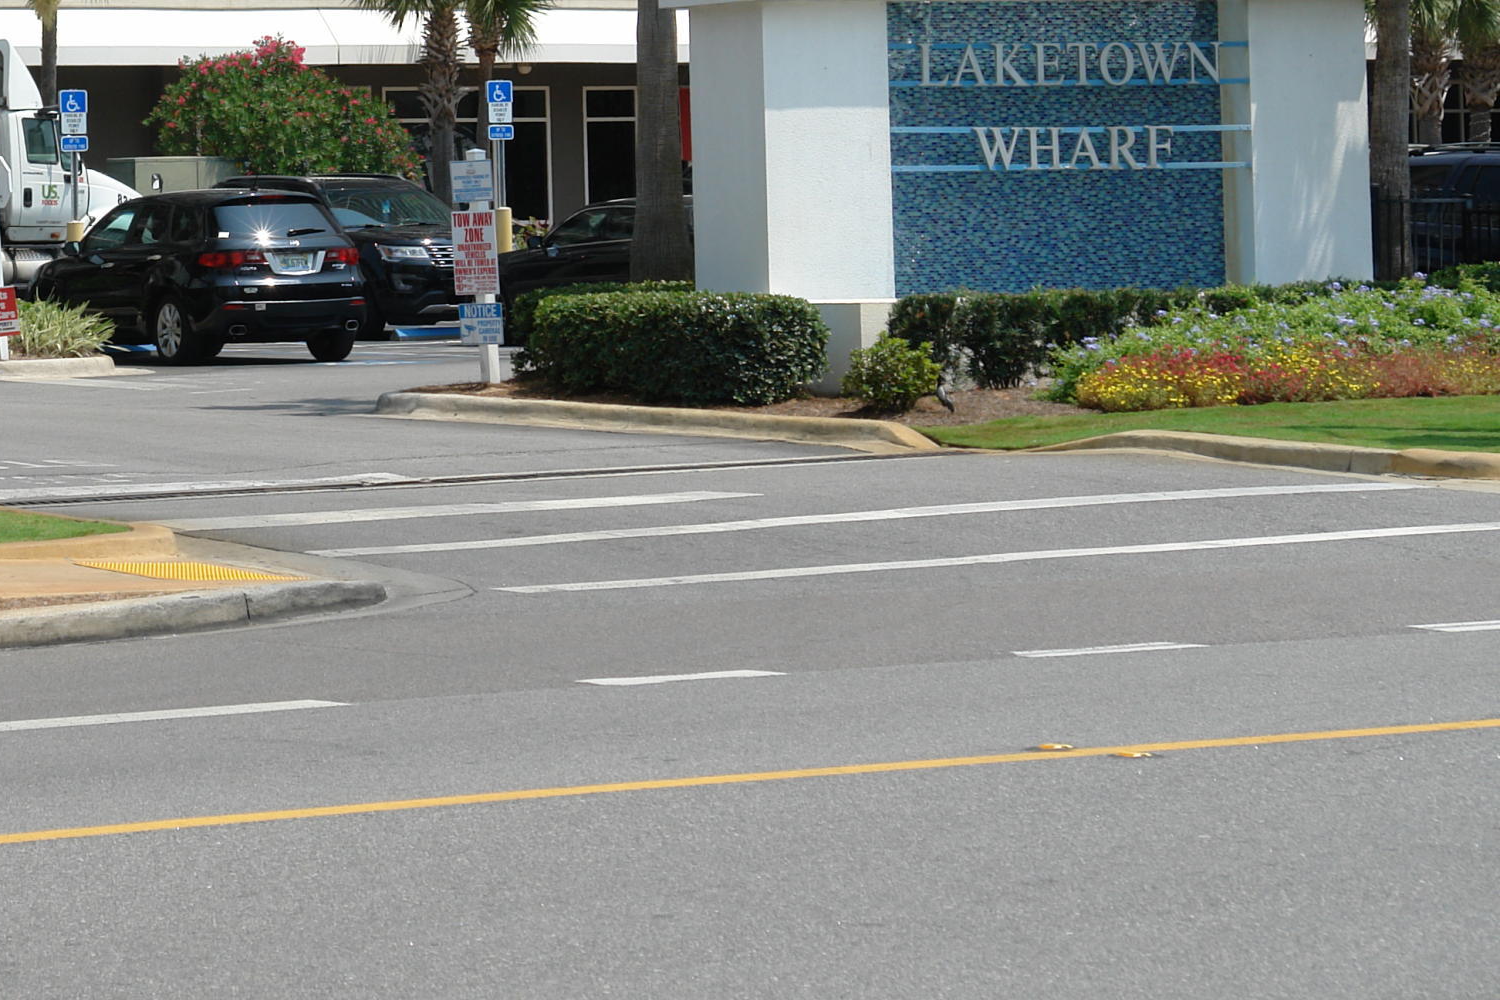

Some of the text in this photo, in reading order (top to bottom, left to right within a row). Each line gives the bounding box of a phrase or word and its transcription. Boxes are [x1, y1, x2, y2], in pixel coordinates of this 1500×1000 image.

[919, 41, 1223, 87] LAKETOWN
[972, 124, 1174, 171] WHARF
[452, 212, 493, 228] TOW AWAY
[464, 228, 484, 243] ZONE
[464, 304, 498, 318] NOTICE
